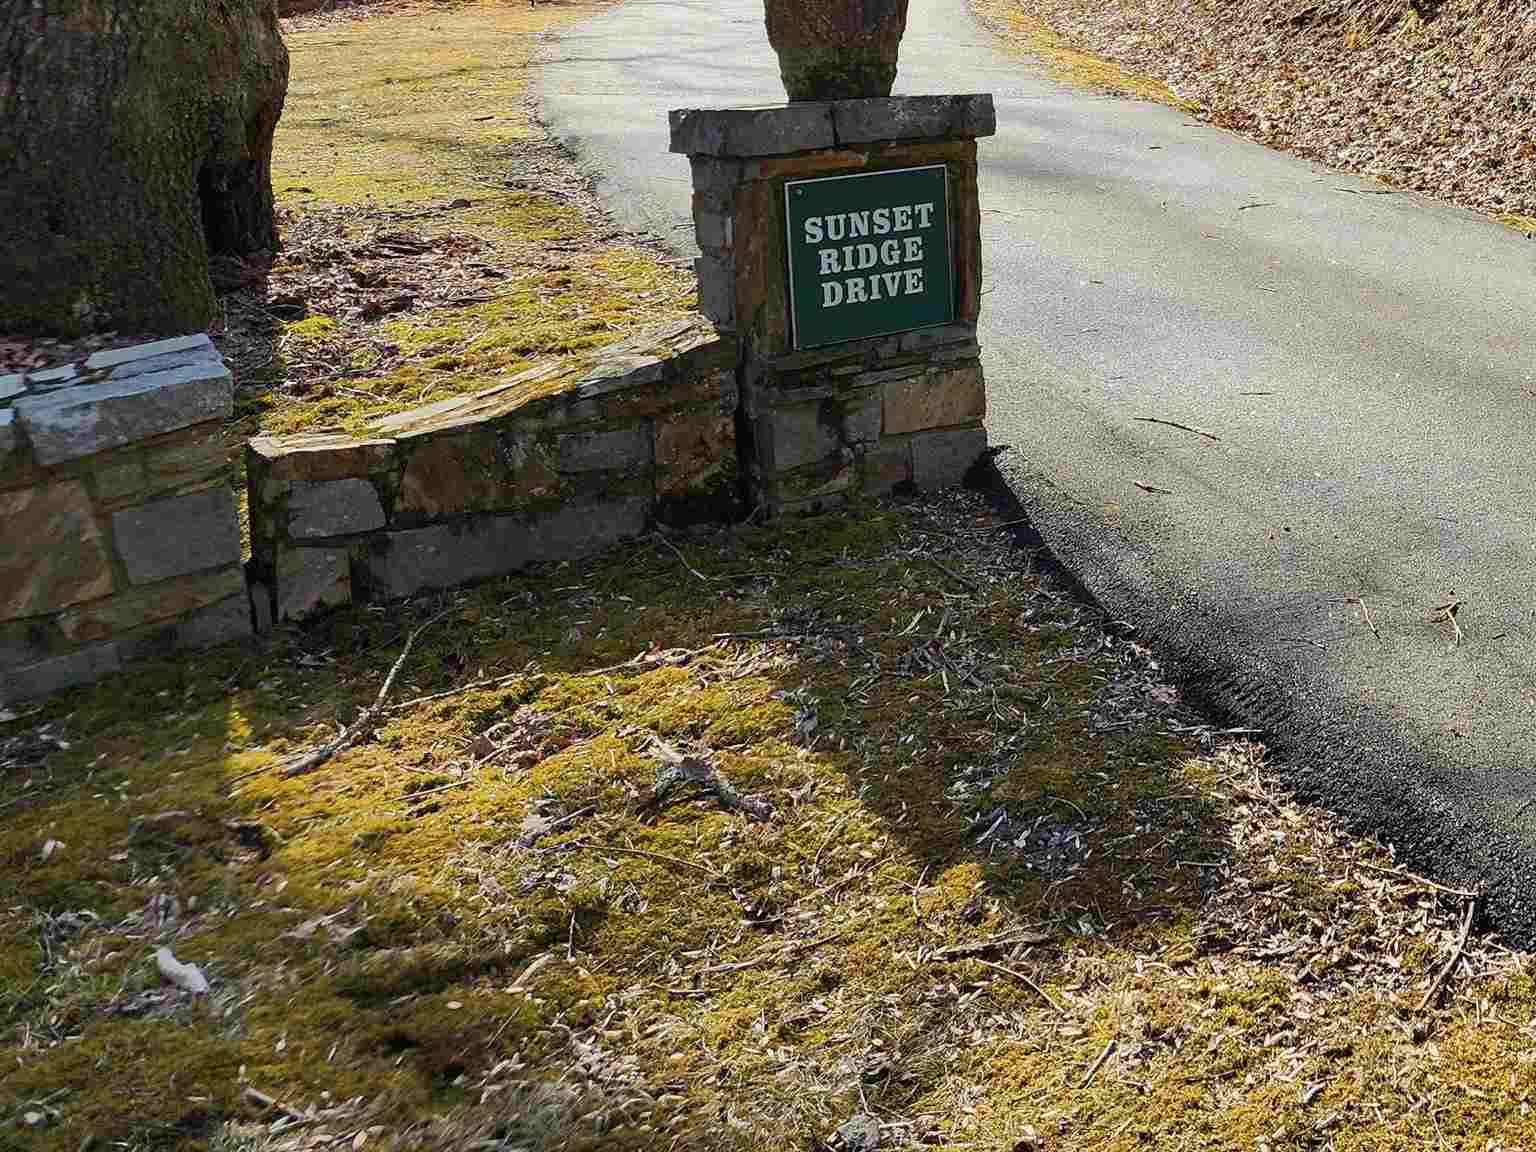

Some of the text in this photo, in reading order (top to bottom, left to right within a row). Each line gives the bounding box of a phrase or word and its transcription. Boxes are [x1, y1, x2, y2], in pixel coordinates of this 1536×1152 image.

[804, 203, 934, 244] SUNSET
[818, 236, 924, 275] RIDGE
[821, 268, 924, 308] DRIVE
